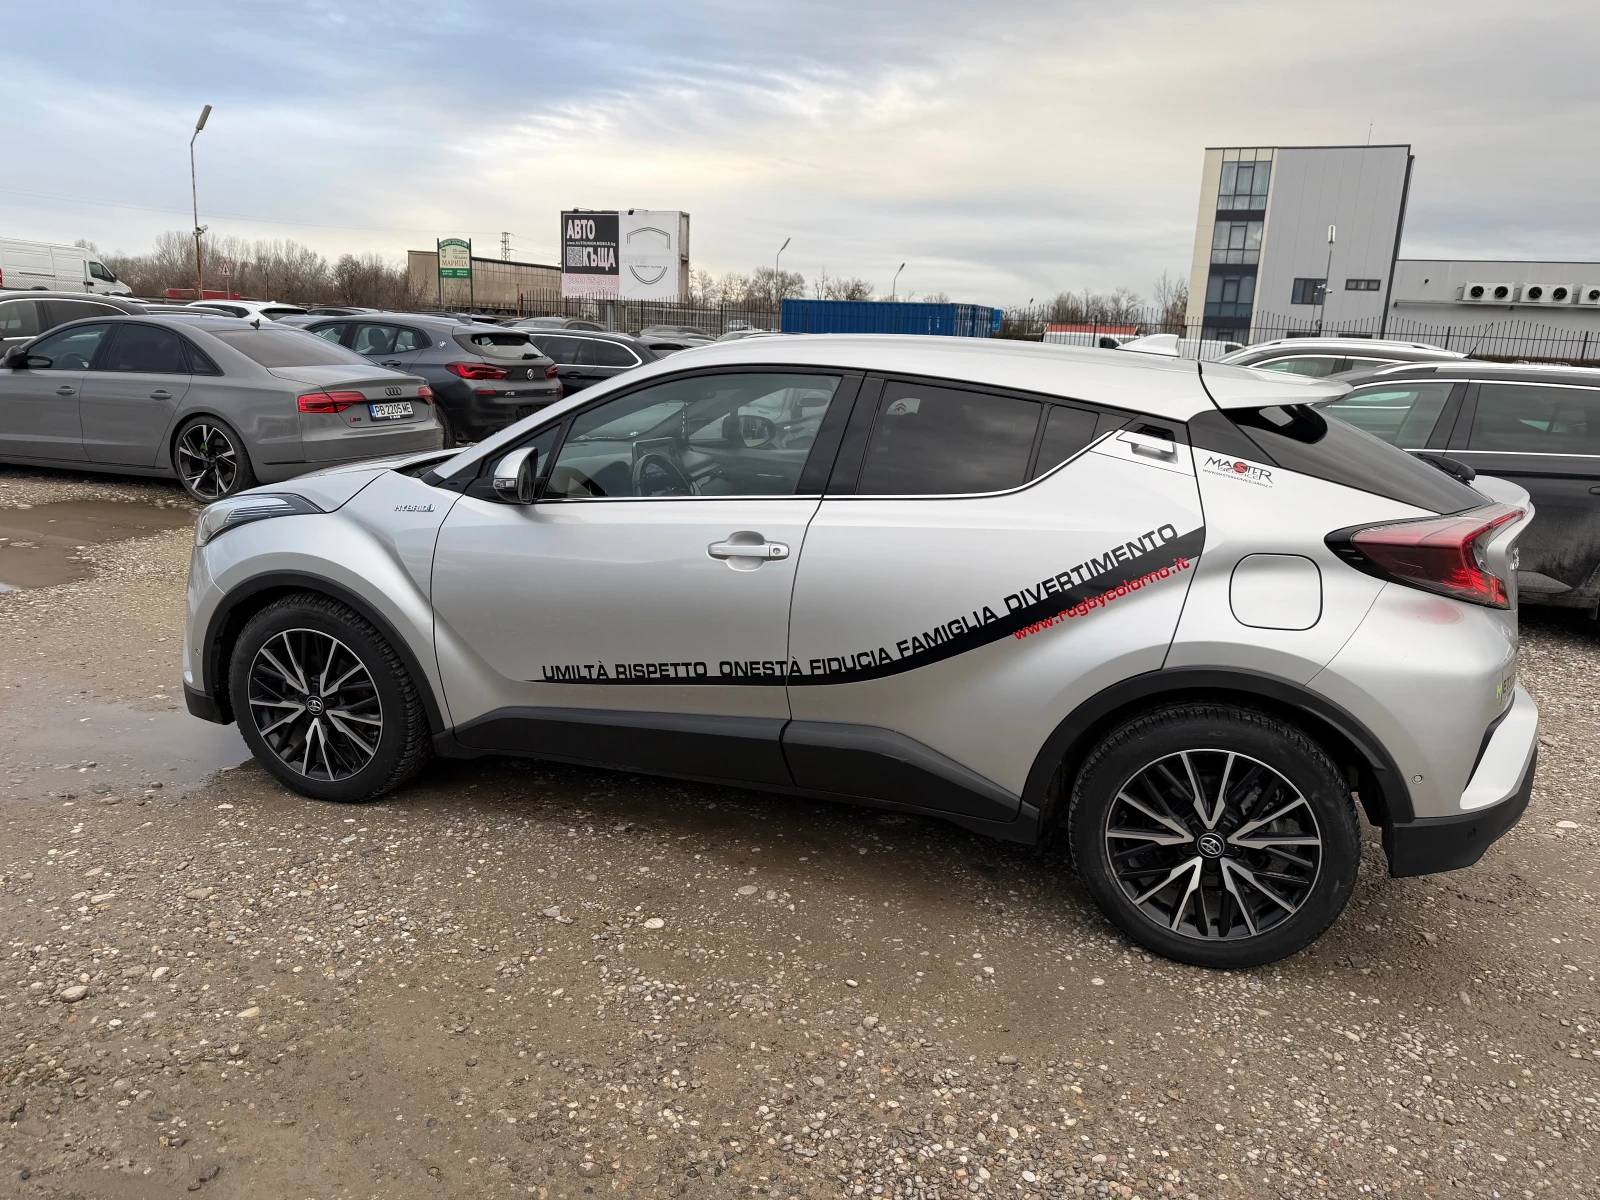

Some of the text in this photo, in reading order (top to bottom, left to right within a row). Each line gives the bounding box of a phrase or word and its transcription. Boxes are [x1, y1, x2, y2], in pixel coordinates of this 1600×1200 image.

[567, 219, 596, 239] АВТО
[582, 247, 616, 271] КЪЩА
[374, 405, 386, 416] PB
[385, 403, 402, 415] 2205
[1203, 456, 1274, 485] MASTER
[542, 523, 1179, 681] UMILTÀ RISPETTO ONESTÀ FIDUCIA FAMIGLIA DIVERTIMENTO
[1012, 556, 1191, 641] www.rugbycolorno.it
